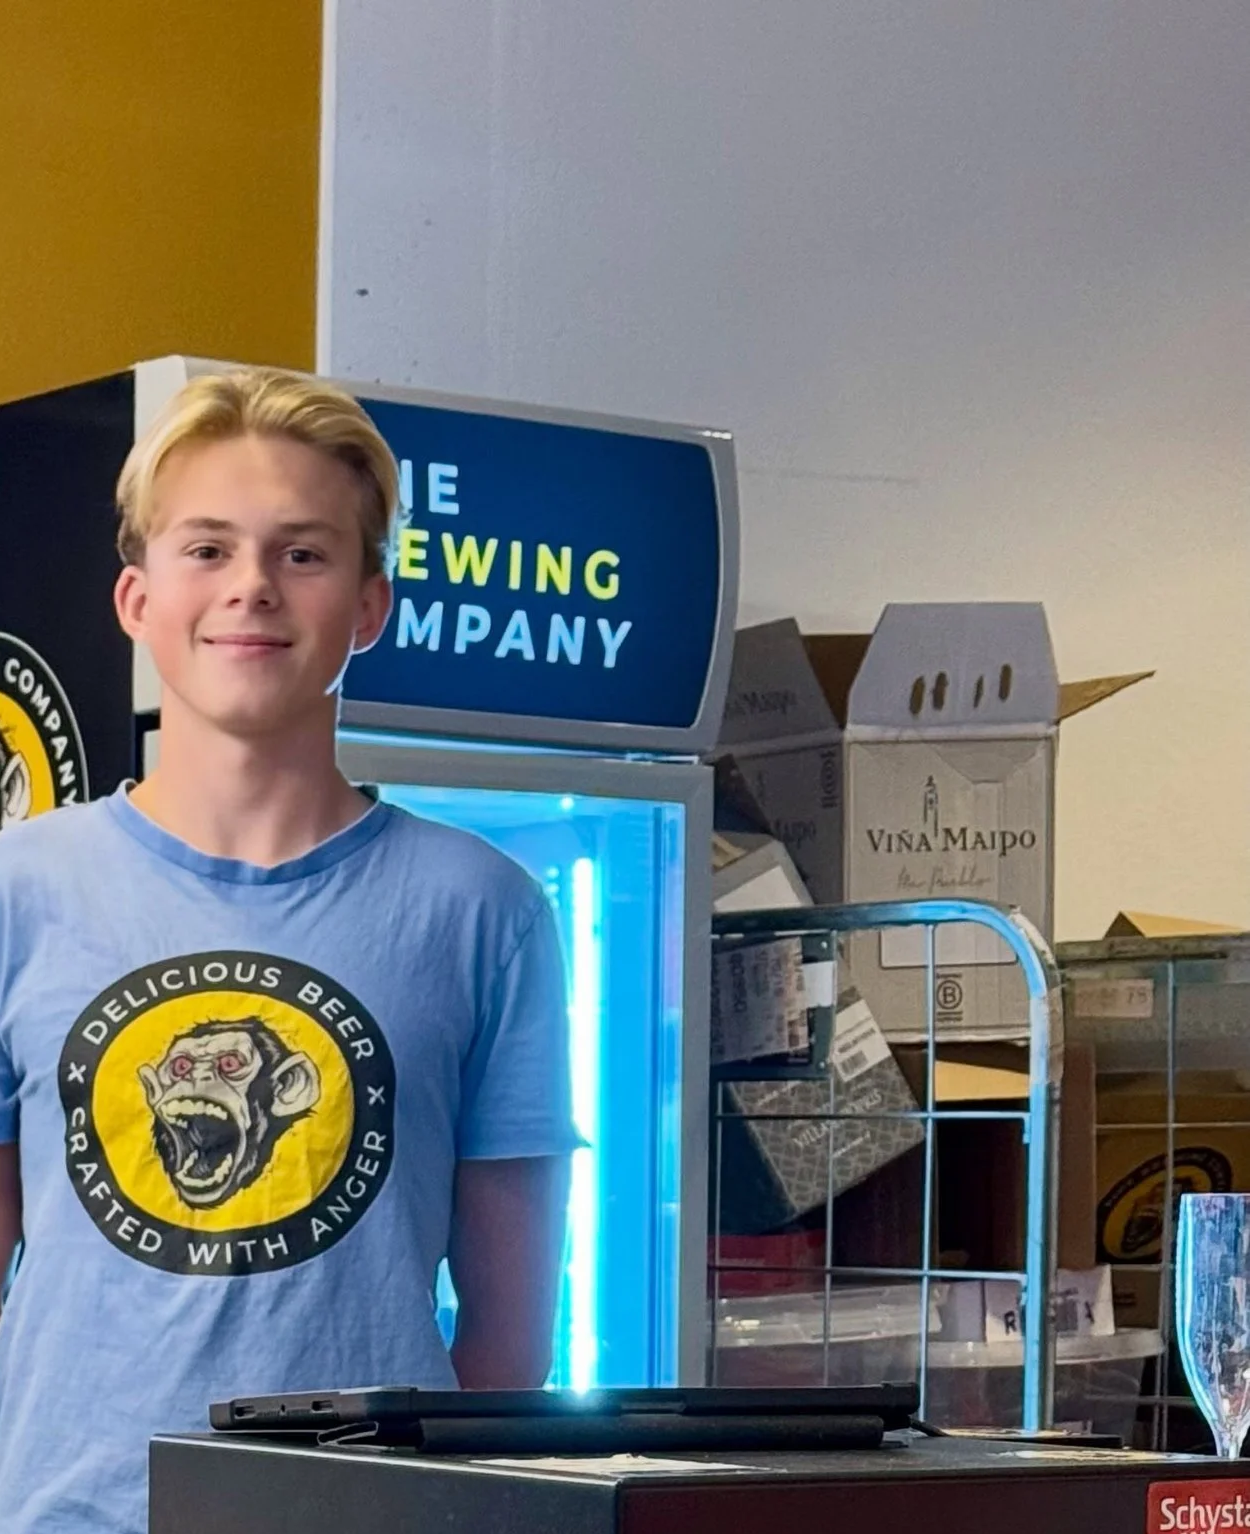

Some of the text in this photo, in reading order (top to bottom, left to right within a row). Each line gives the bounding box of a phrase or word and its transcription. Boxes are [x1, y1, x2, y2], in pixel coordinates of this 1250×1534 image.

[397, 527, 621, 600] EWING
[395, 597, 633, 669] MPANY
[3, 657, 81, 805] COMPANY
[866, 828, 933, 853] VIÑA
[81, 960, 283, 1046] DELICIOUS
[296, 980, 376, 1061] BEER
[68, 1105, 387, 1266] CRAFTED WITH ANGER
